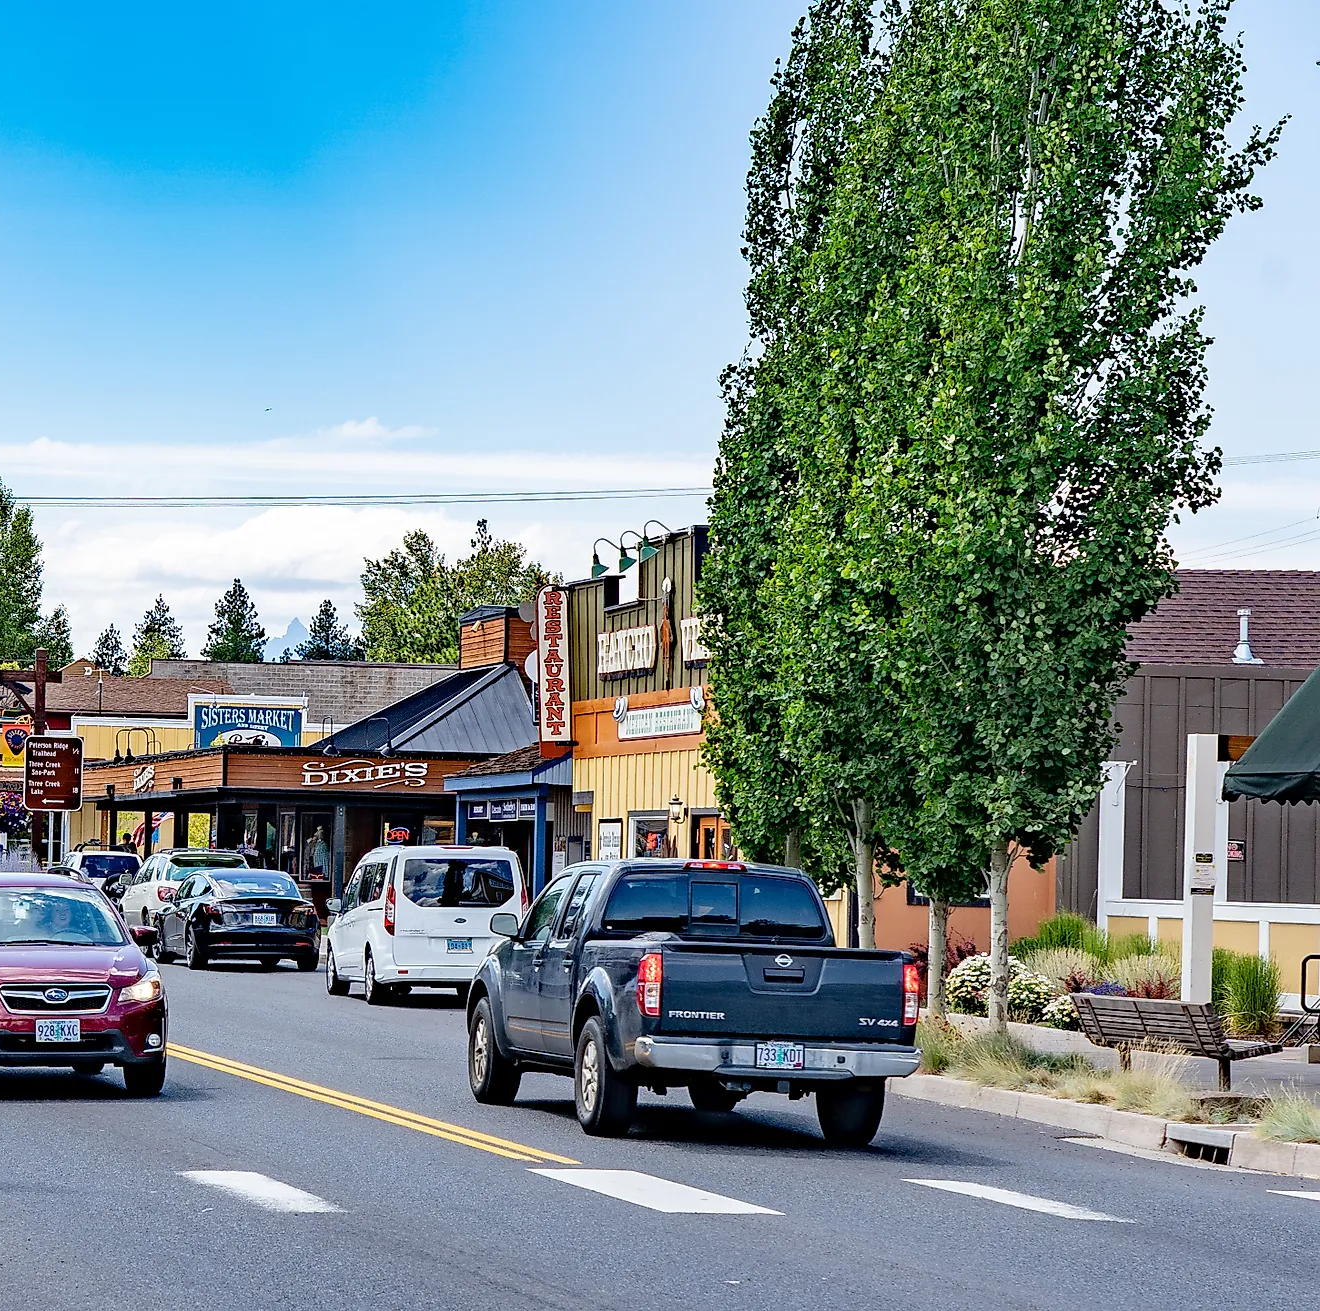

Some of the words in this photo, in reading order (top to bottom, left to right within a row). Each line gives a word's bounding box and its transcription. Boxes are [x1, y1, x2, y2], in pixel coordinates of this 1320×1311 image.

[597, 625, 656, 674] RANCHO
[543, 591, 565, 735] RESTAURANT
[200, 707, 246, 729] SISTERS
[247, 709, 295, 732] MARKET
[53, 742, 68, 750] Ridge
[301, 762, 428, 786] DIXIE'S
[386, 830, 409, 841] OPEN
[668, 1010, 726, 1020] FRONTIER
[858, 1017, 876, 1026] SV
[38, 1024, 55, 1037] 928
[60, 1024, 78, 1037] KXC
[757, 1047, 776, 1062] 733
[783, 1048, 802, 1062] KDT
